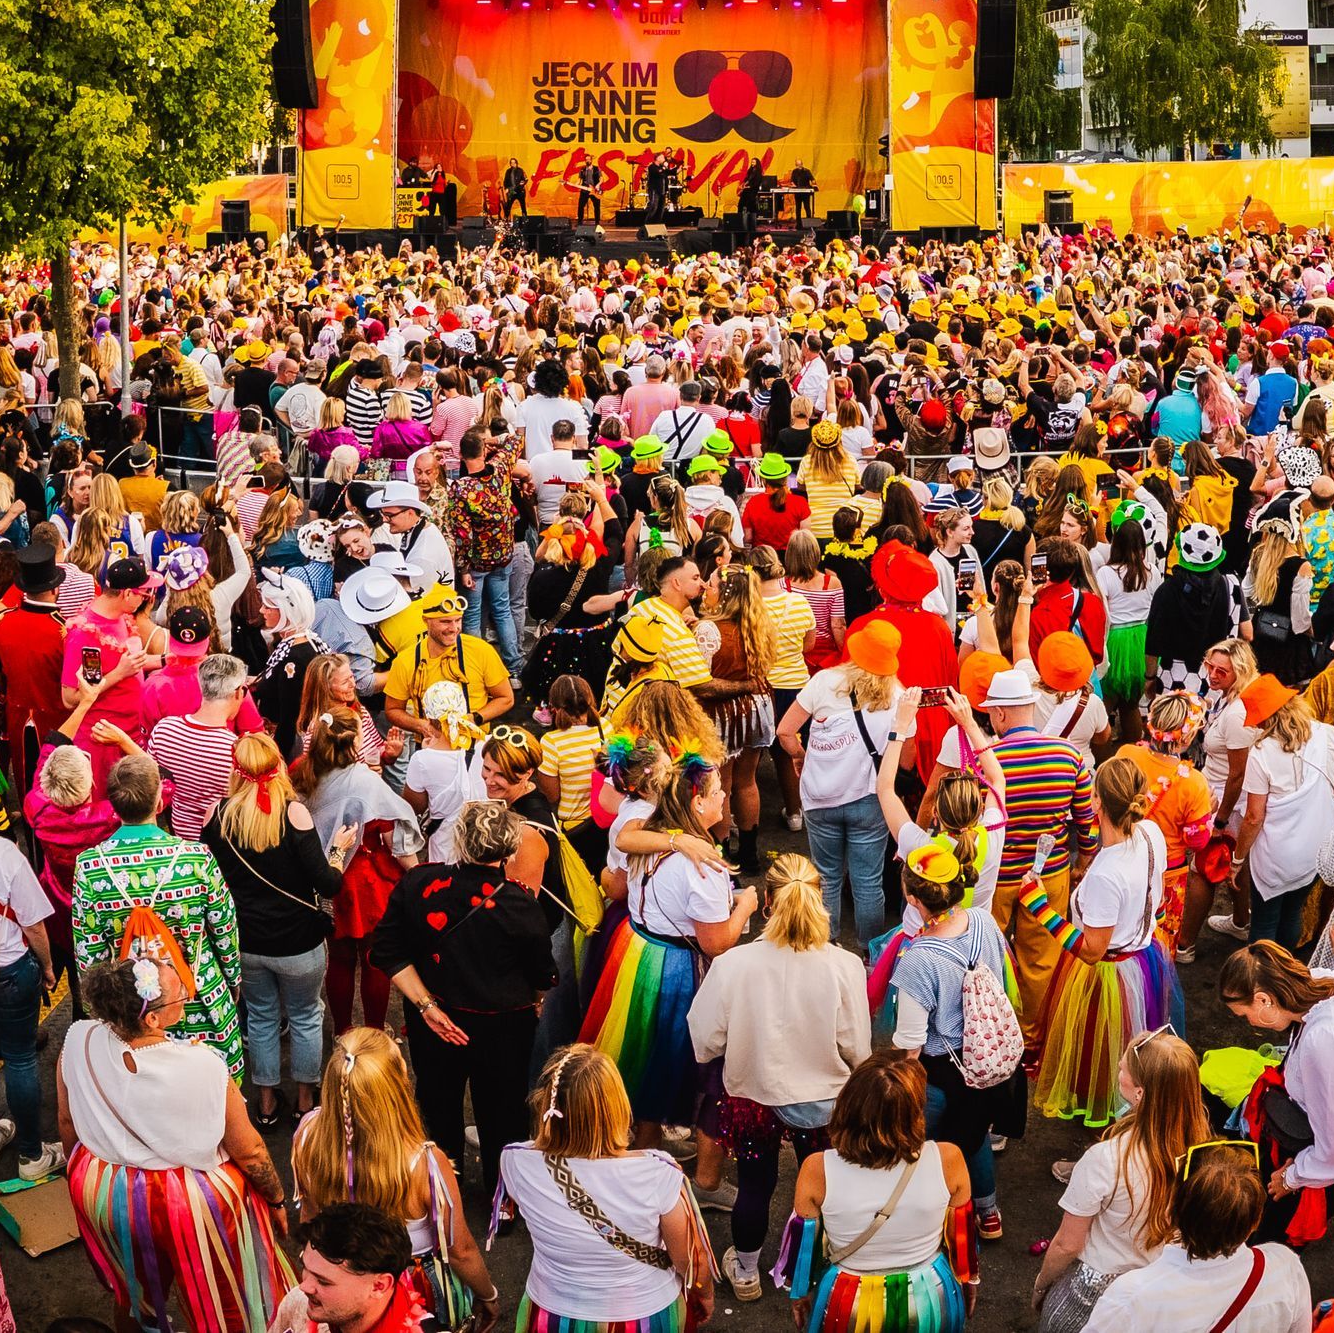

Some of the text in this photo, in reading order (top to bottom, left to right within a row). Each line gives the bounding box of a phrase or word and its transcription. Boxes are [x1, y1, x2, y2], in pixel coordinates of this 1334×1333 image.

[532, 62, 658, 87] JECK IM
[533, 90, 657, 116] SUNNE
[533, 118, 656, 143] SCHING
